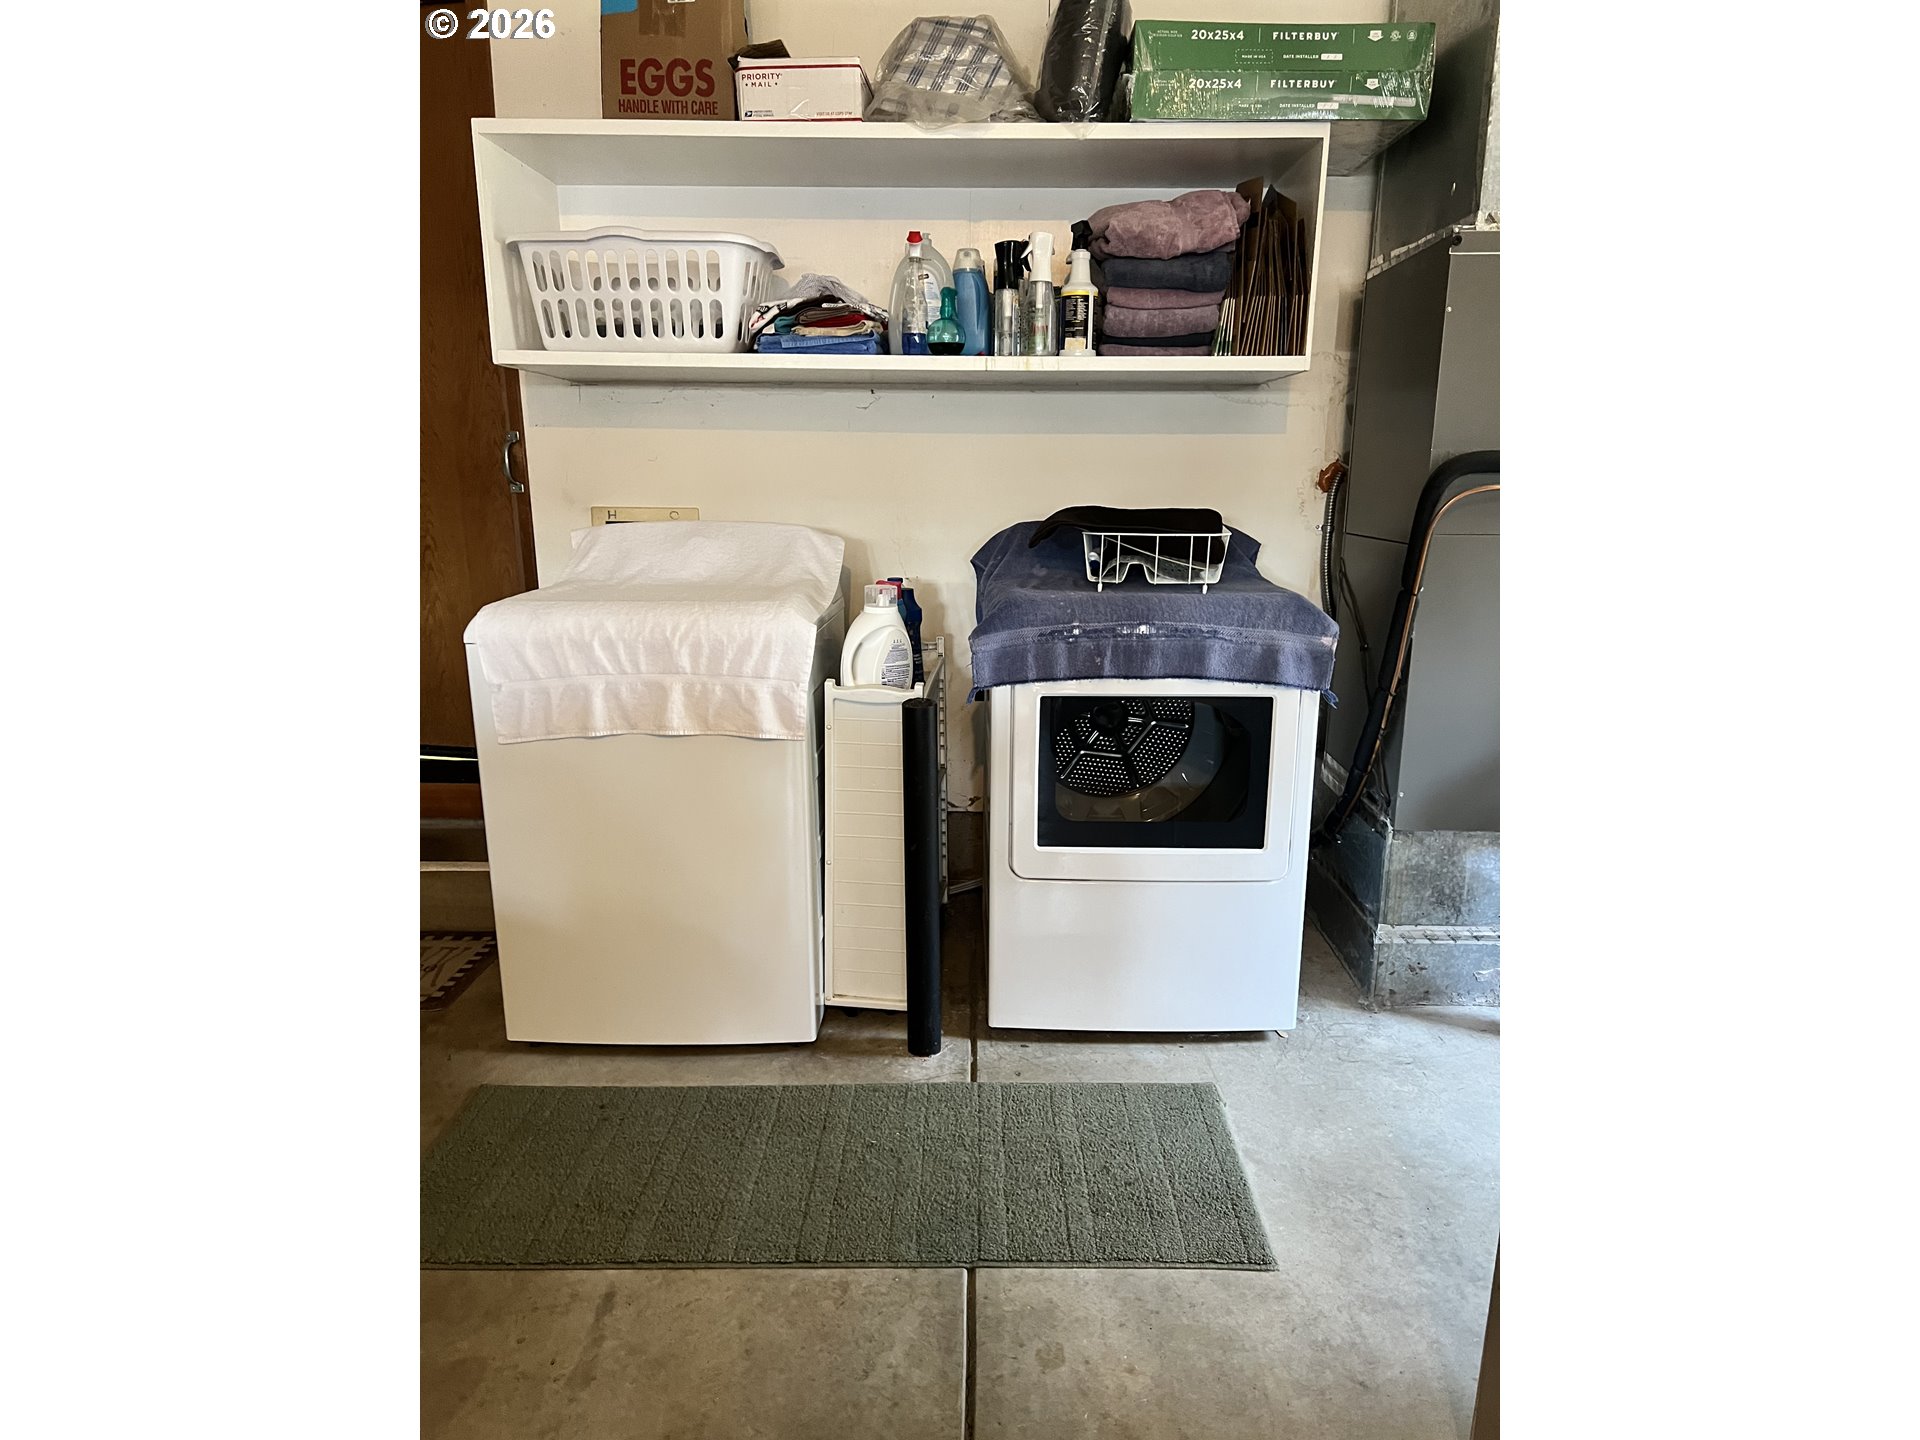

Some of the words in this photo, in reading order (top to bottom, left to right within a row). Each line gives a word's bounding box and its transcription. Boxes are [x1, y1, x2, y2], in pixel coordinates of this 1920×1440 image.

[1190, 29, 1245, 40] 20x25x4
[1272, 32, 1338, 40] FILTERBUY
[619, 57, 715, 97] EGGS
[741, 72, 781, 80] PRIORITY
[1188, 78, 1242, 89] 20x25x4
[1270, 79, 1336, 88] FILTERBUY
[618, 98, 660, 114] HANDLE
[661, 99, 689, 115] WITH
[690, 100, 719, 116] CARE
[607, 510, 617, 520] H
[669, 510, 680, 520] C
